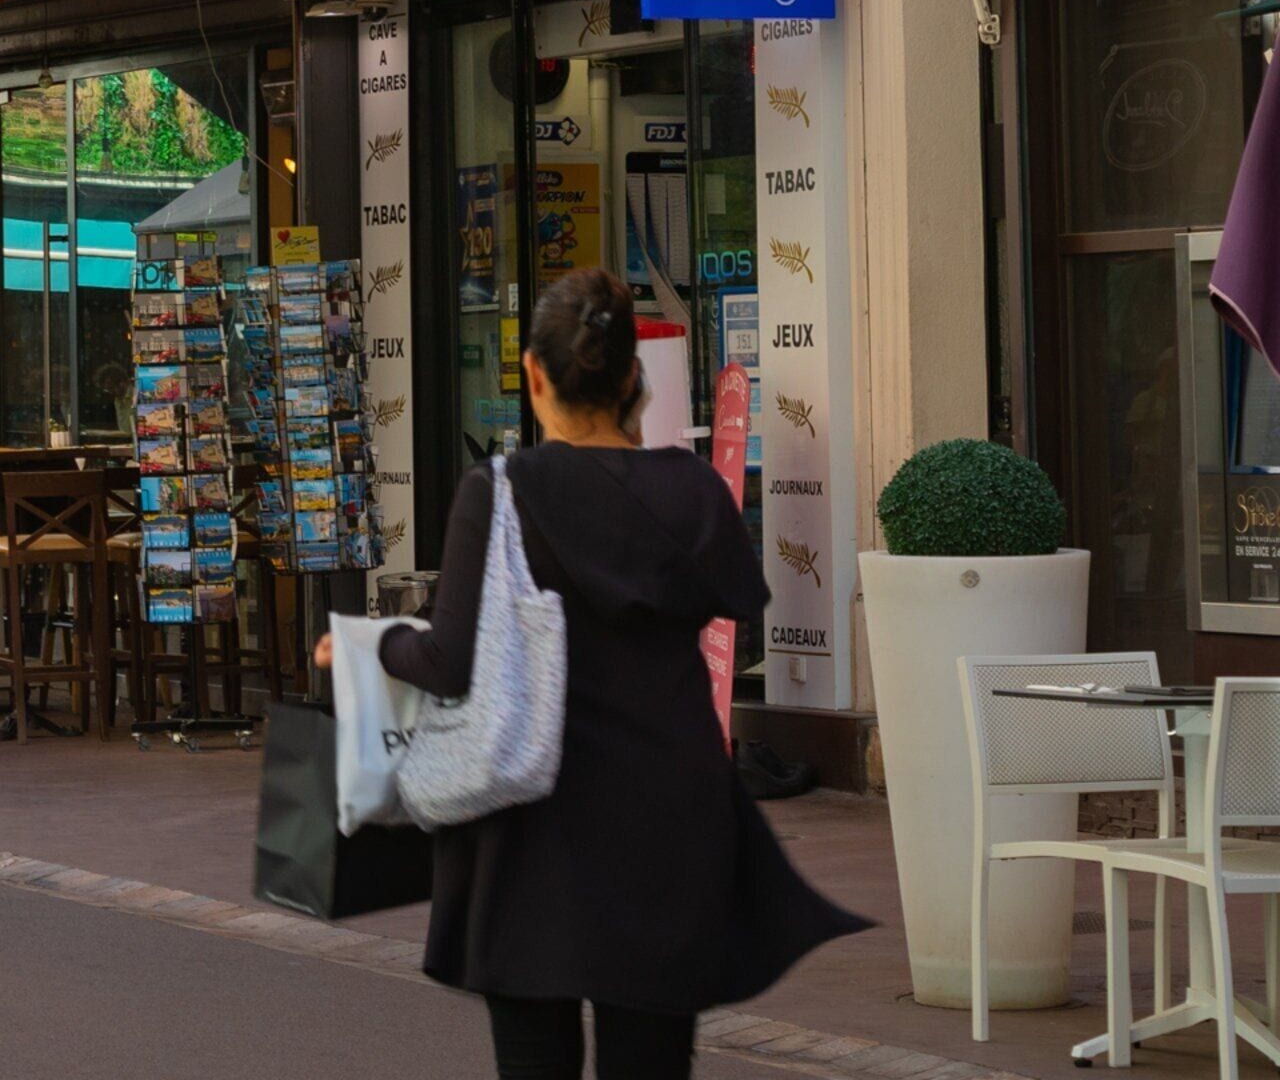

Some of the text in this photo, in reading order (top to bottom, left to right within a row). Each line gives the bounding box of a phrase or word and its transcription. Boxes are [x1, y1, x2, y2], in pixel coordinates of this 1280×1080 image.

[369, 21, 397, 41] CAVE
[761, 19, 813, 42] CIGARES
[379, 50, 388, 66] A
[360, 73, 407, 95] CIGARES
[534, 124, 552, 139] DJ
[647, 124, 677, 140] FDJ
[765, 167, 816, 196] TABAC
[364, 203, 407, 226] TABAC
[697, 249, 752, 281] IQOS
[772, 323, 814, 348] JEUX
[370, 338, 405, 359] JEUX
[372, 470, 412, 486] OURNAUX
[769, 480, 823, 497] JOURNAUX
[771, 625, 827, 649] CADEAUX
